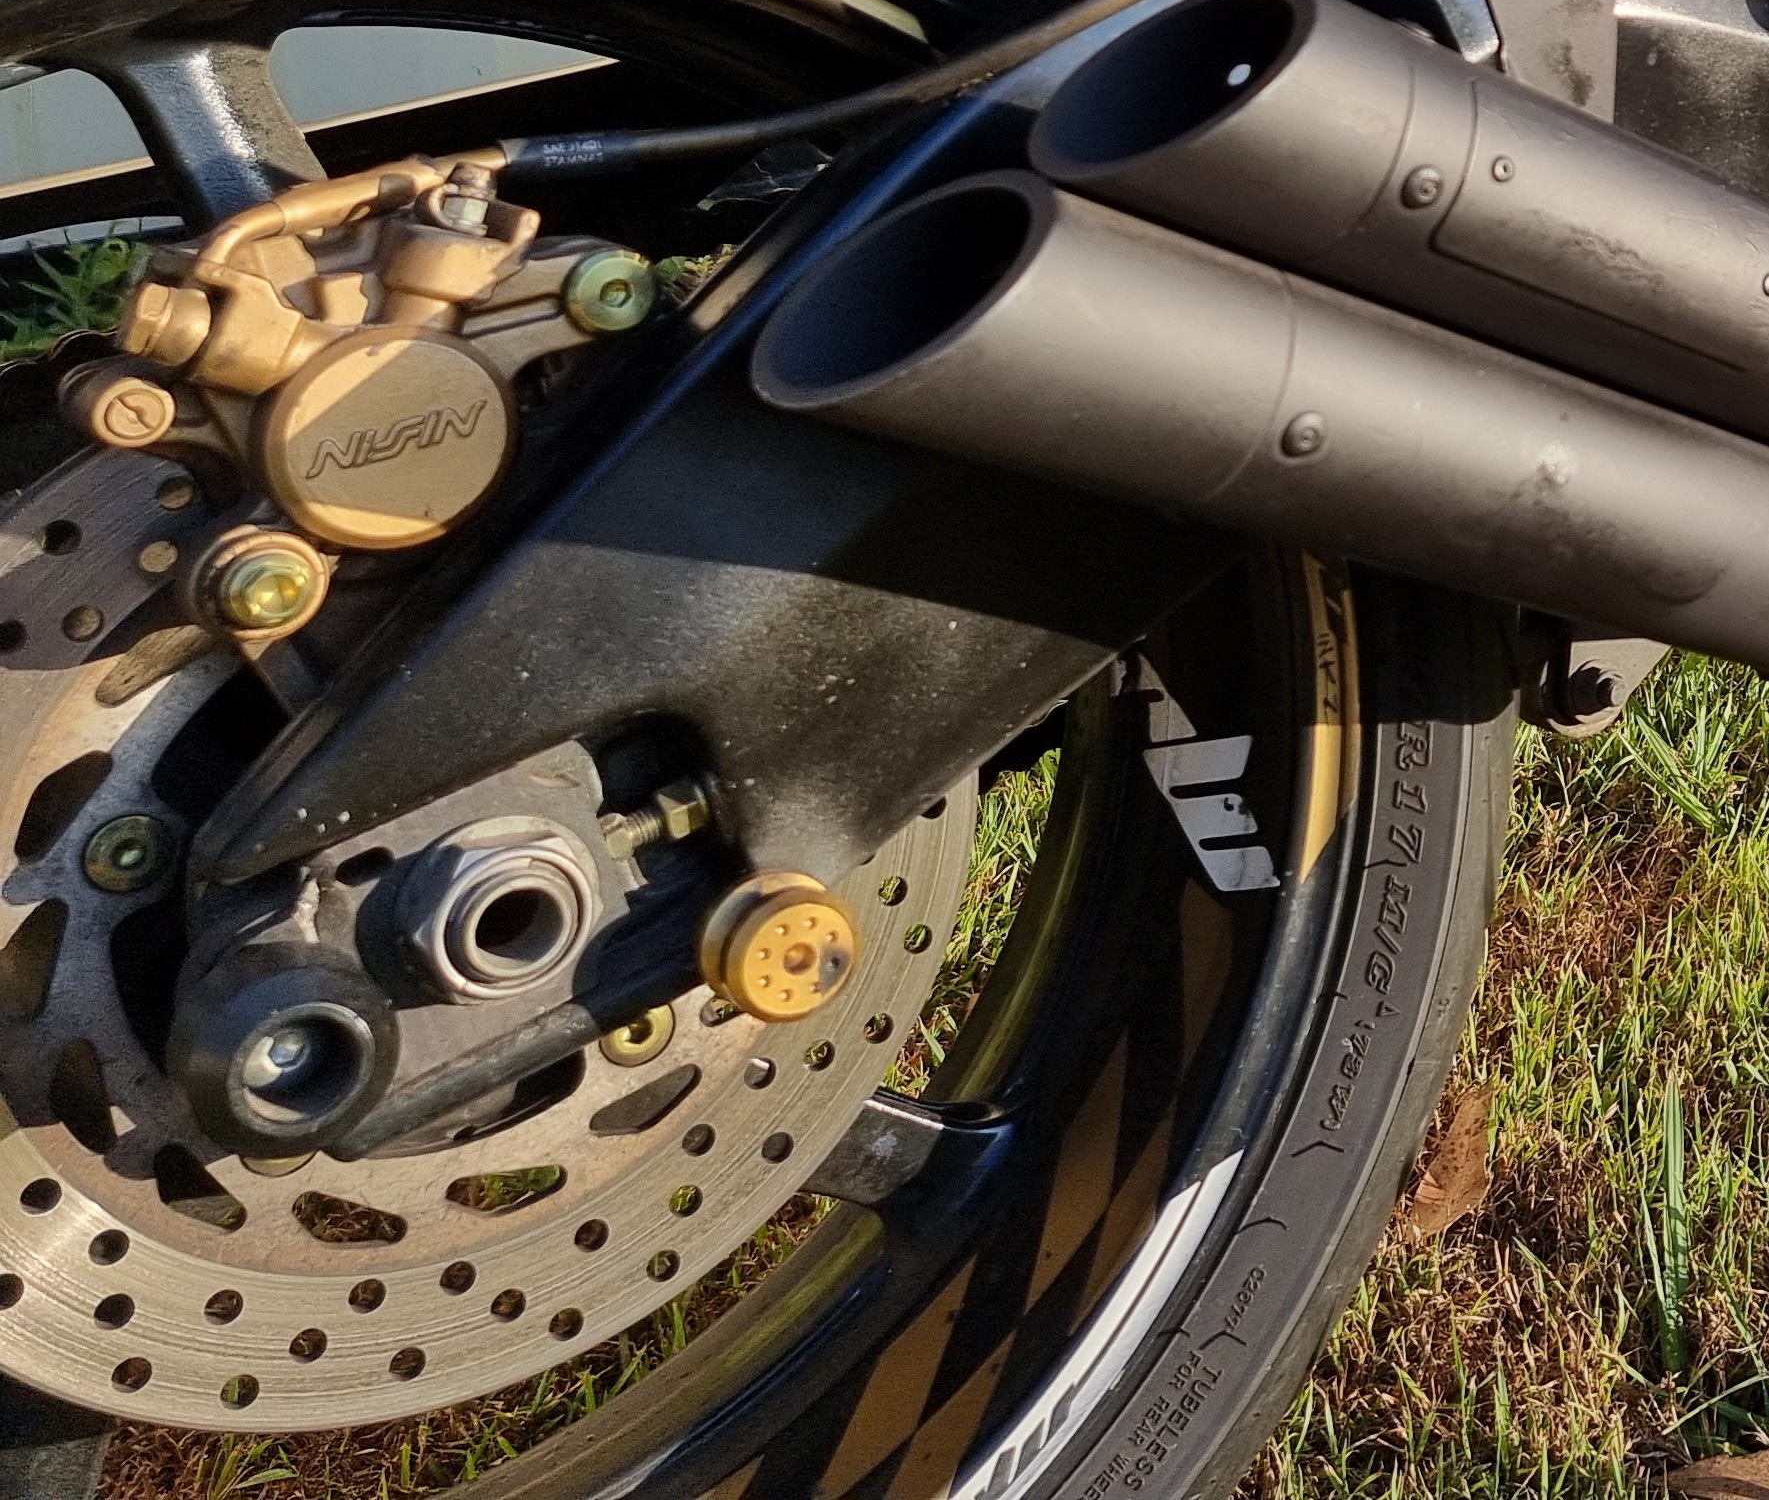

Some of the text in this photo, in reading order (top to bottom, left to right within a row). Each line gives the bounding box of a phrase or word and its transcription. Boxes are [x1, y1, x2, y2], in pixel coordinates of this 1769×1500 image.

[305, 399, 488, 481] NISSIN
[1077, 1350, 1204, 1500] FOR REAR WHEE
[1123, 1363, 1224, 1492] TUBELESS
